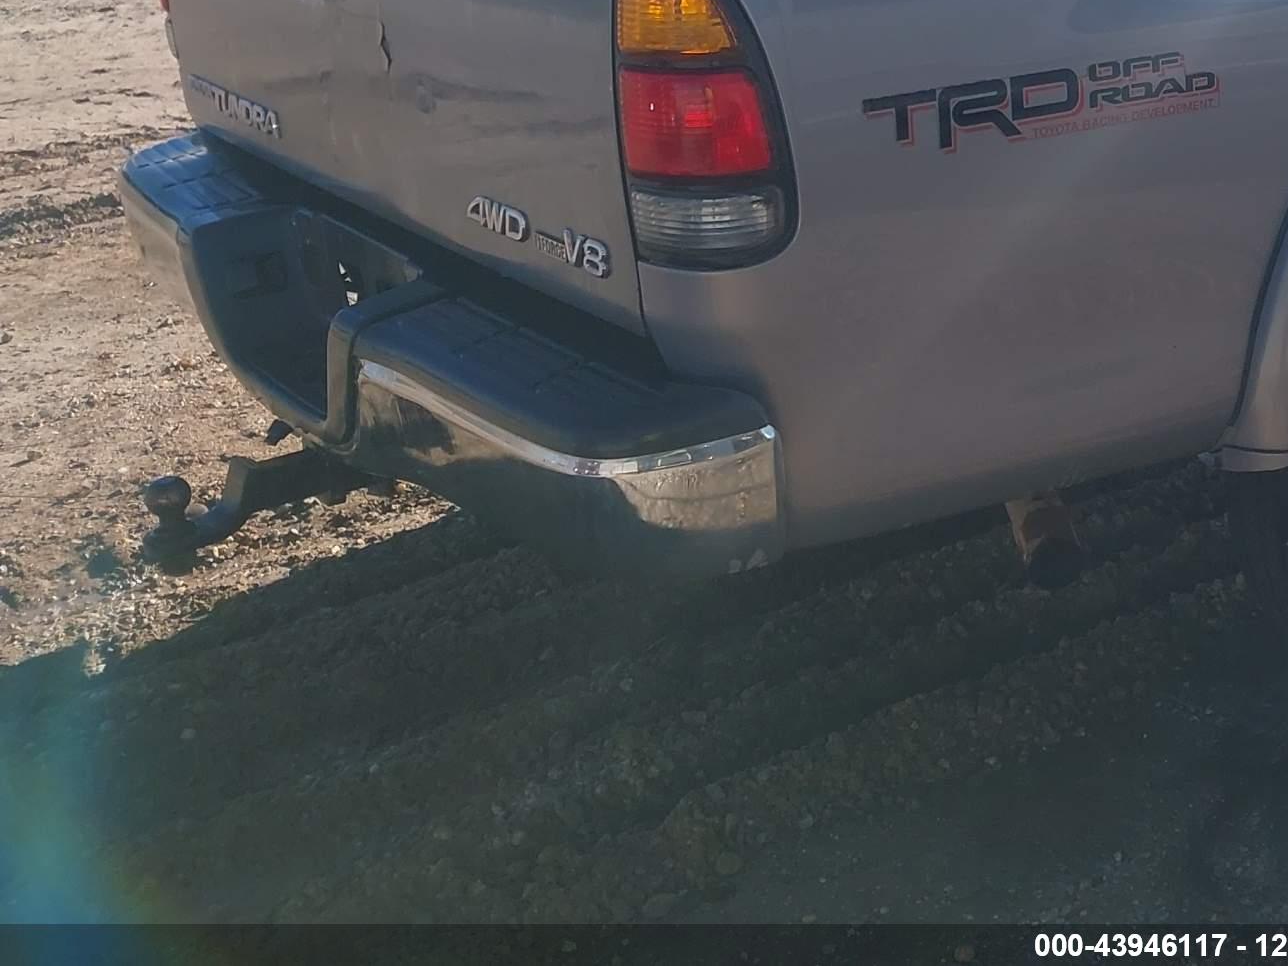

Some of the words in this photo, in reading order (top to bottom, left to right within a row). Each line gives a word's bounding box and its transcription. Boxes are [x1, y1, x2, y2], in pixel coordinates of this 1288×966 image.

[1087, 51, 1185, 82] OFF
[210, 87, 281, 139] TUNDRA
[862, 67, 1083, 154] TRD
[1089, 71, 1219, 111] ROAD
[1032, 120, 1081, 138] TOYOTA
[1132, 98, 1215, 122] DEVELOPMENT
[466, 196, 528, 242] 4WD
[563, 228, 609, 277] V8
